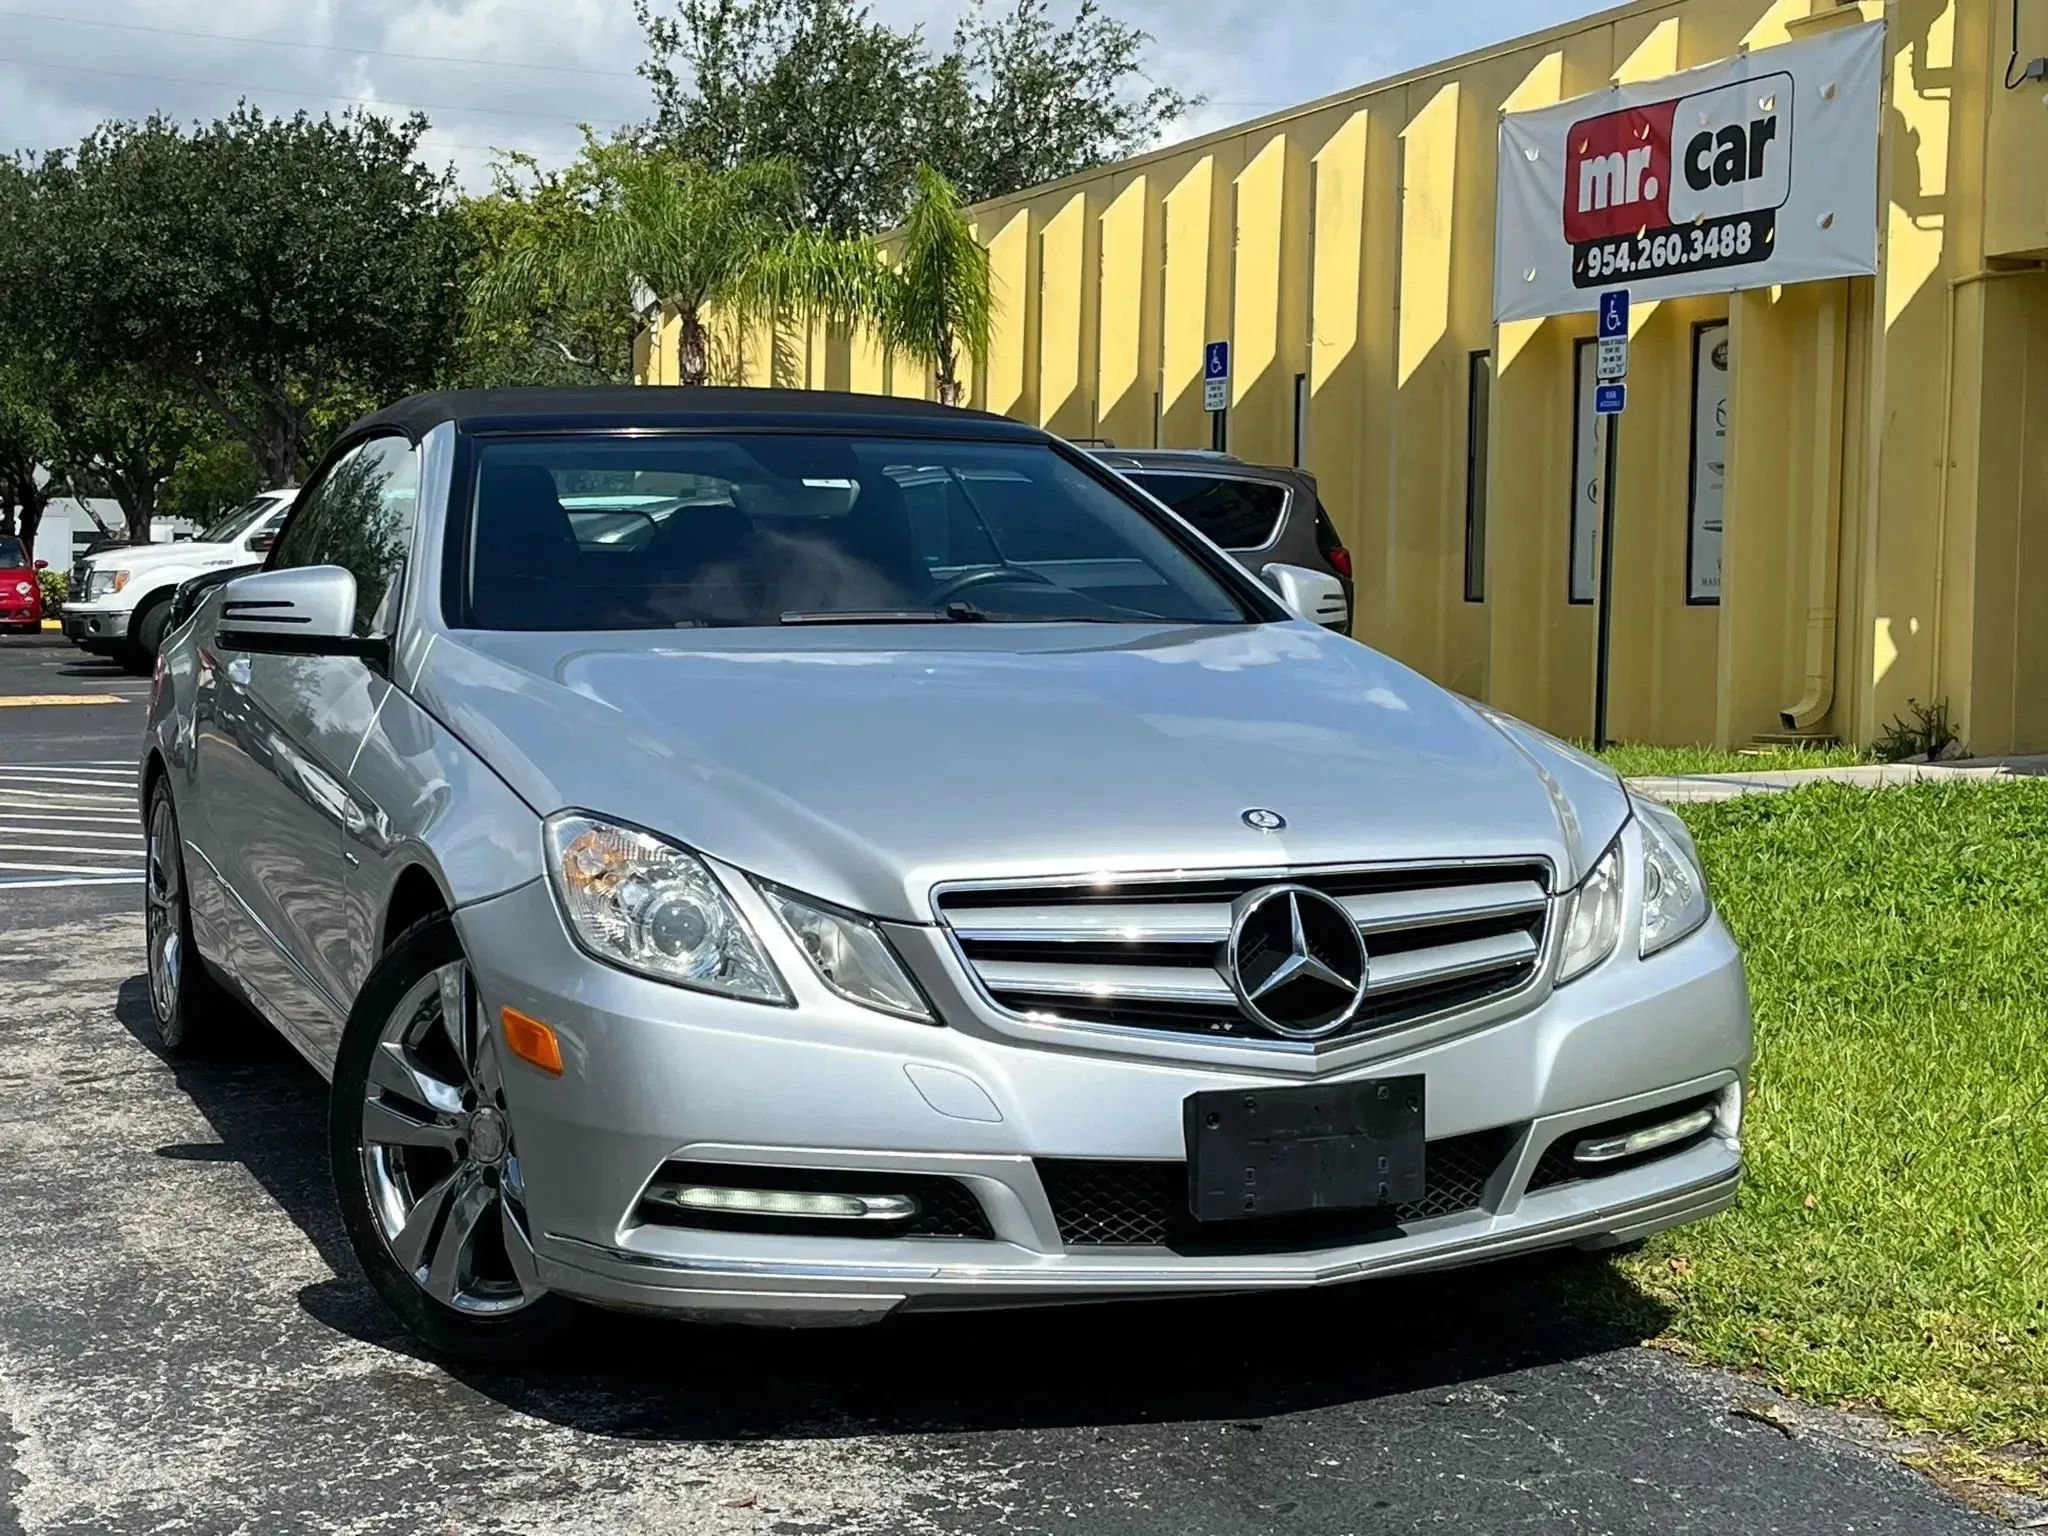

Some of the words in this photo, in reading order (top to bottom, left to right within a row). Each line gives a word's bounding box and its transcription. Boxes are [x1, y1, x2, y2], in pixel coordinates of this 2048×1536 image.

[1578, 144, 1659, 213] mr.
[1684, 115, 1777, 192] car
[1587, 221, 1752, 278] 954.260.3488
